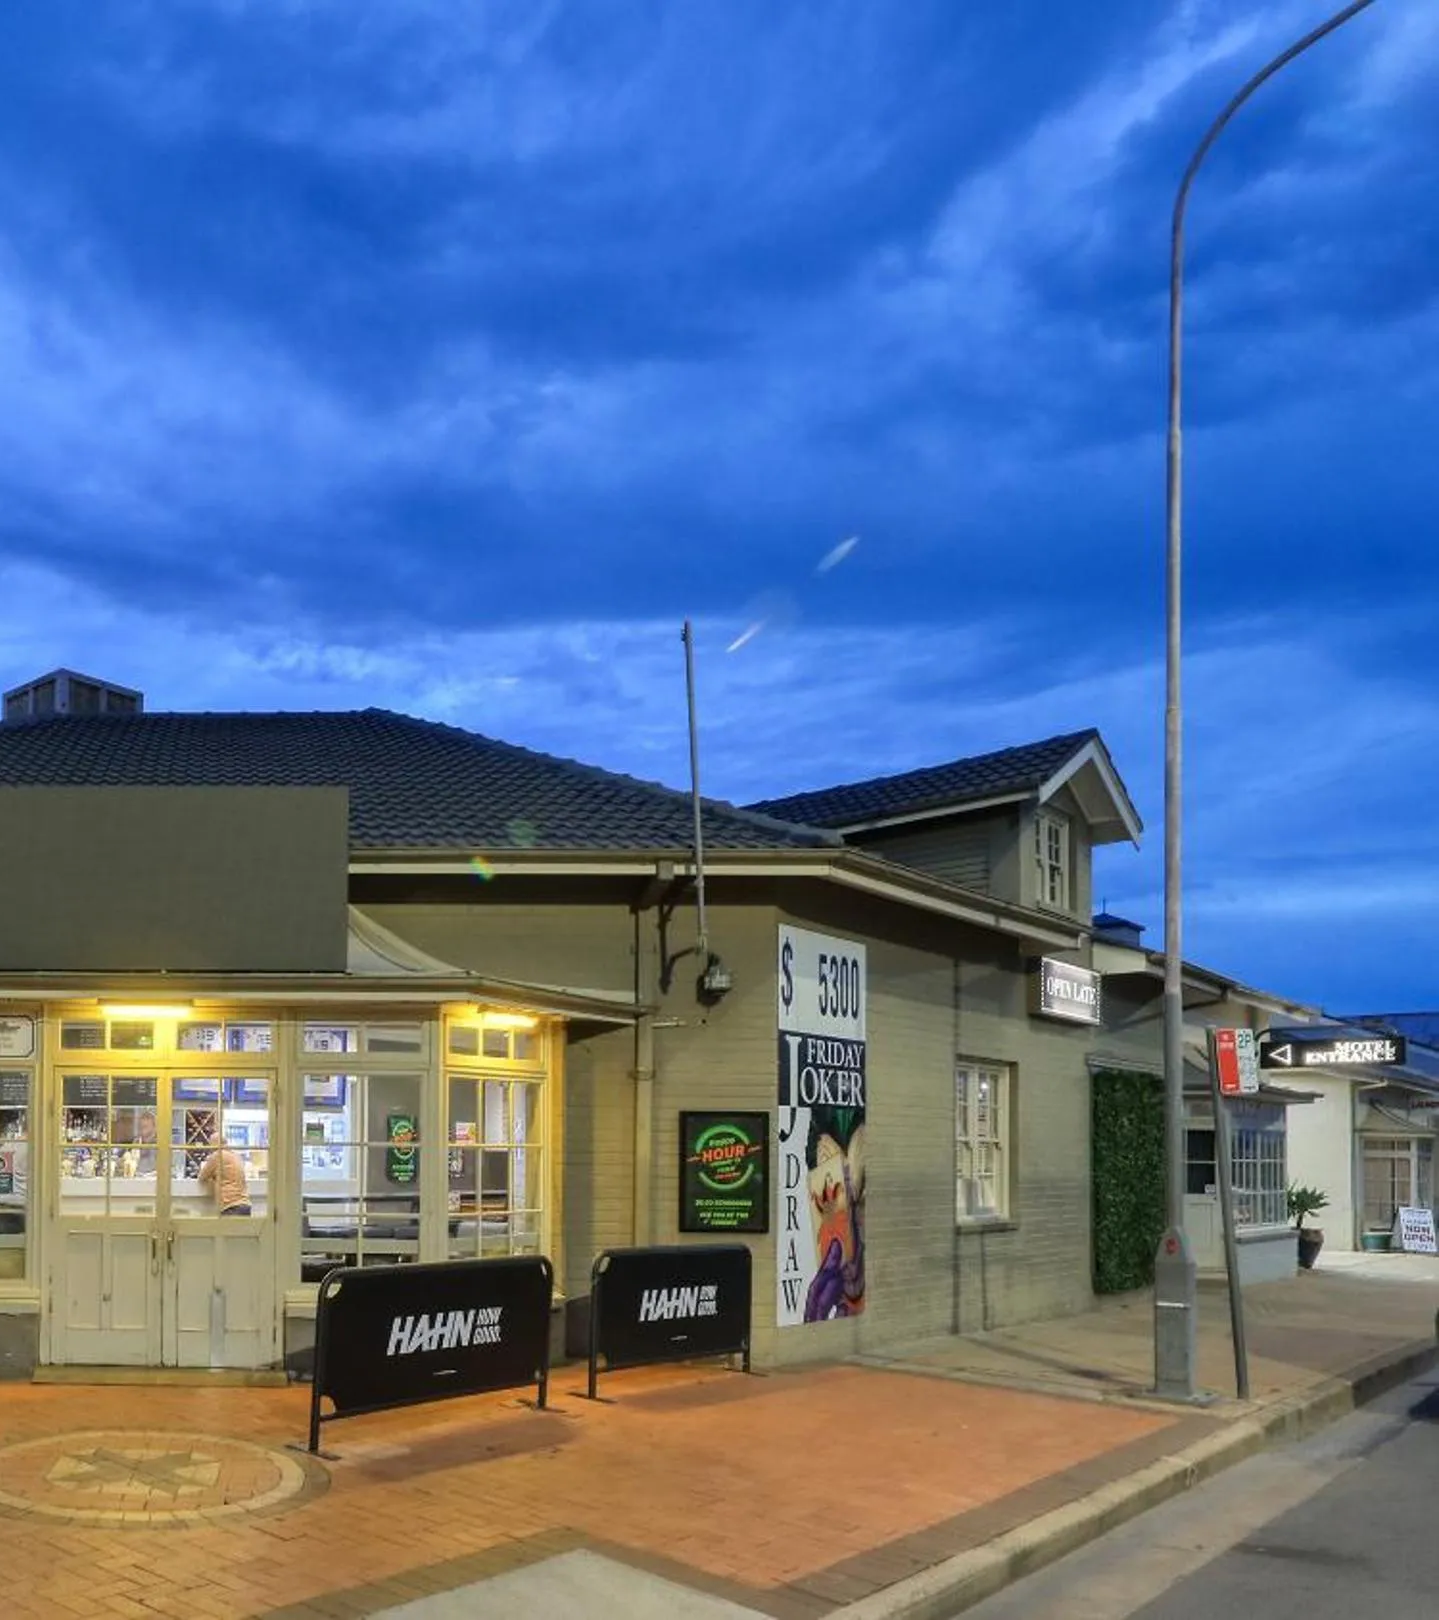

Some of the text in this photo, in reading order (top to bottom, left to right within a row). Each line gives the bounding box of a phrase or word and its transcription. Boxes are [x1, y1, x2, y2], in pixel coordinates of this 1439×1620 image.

[818, 953, 860, 1020] 5300
[1047, 976, 1071, 999] OPEN
[807, 1038, 864, 1069] FRIDAY
[1238, 1033, 1252, 1049] 2P
[1334, 1040, 1395, 1054] MOTEL
[1305, 1049, 1396, 1063] ENTRANCE
[702, 1145, 746, 1162] HOUR
[781, 1152, 803, 1312] DRAW
[639, 1286, 699, 1322] HAHN
[386, 1309, 477, 1356] HAHN
